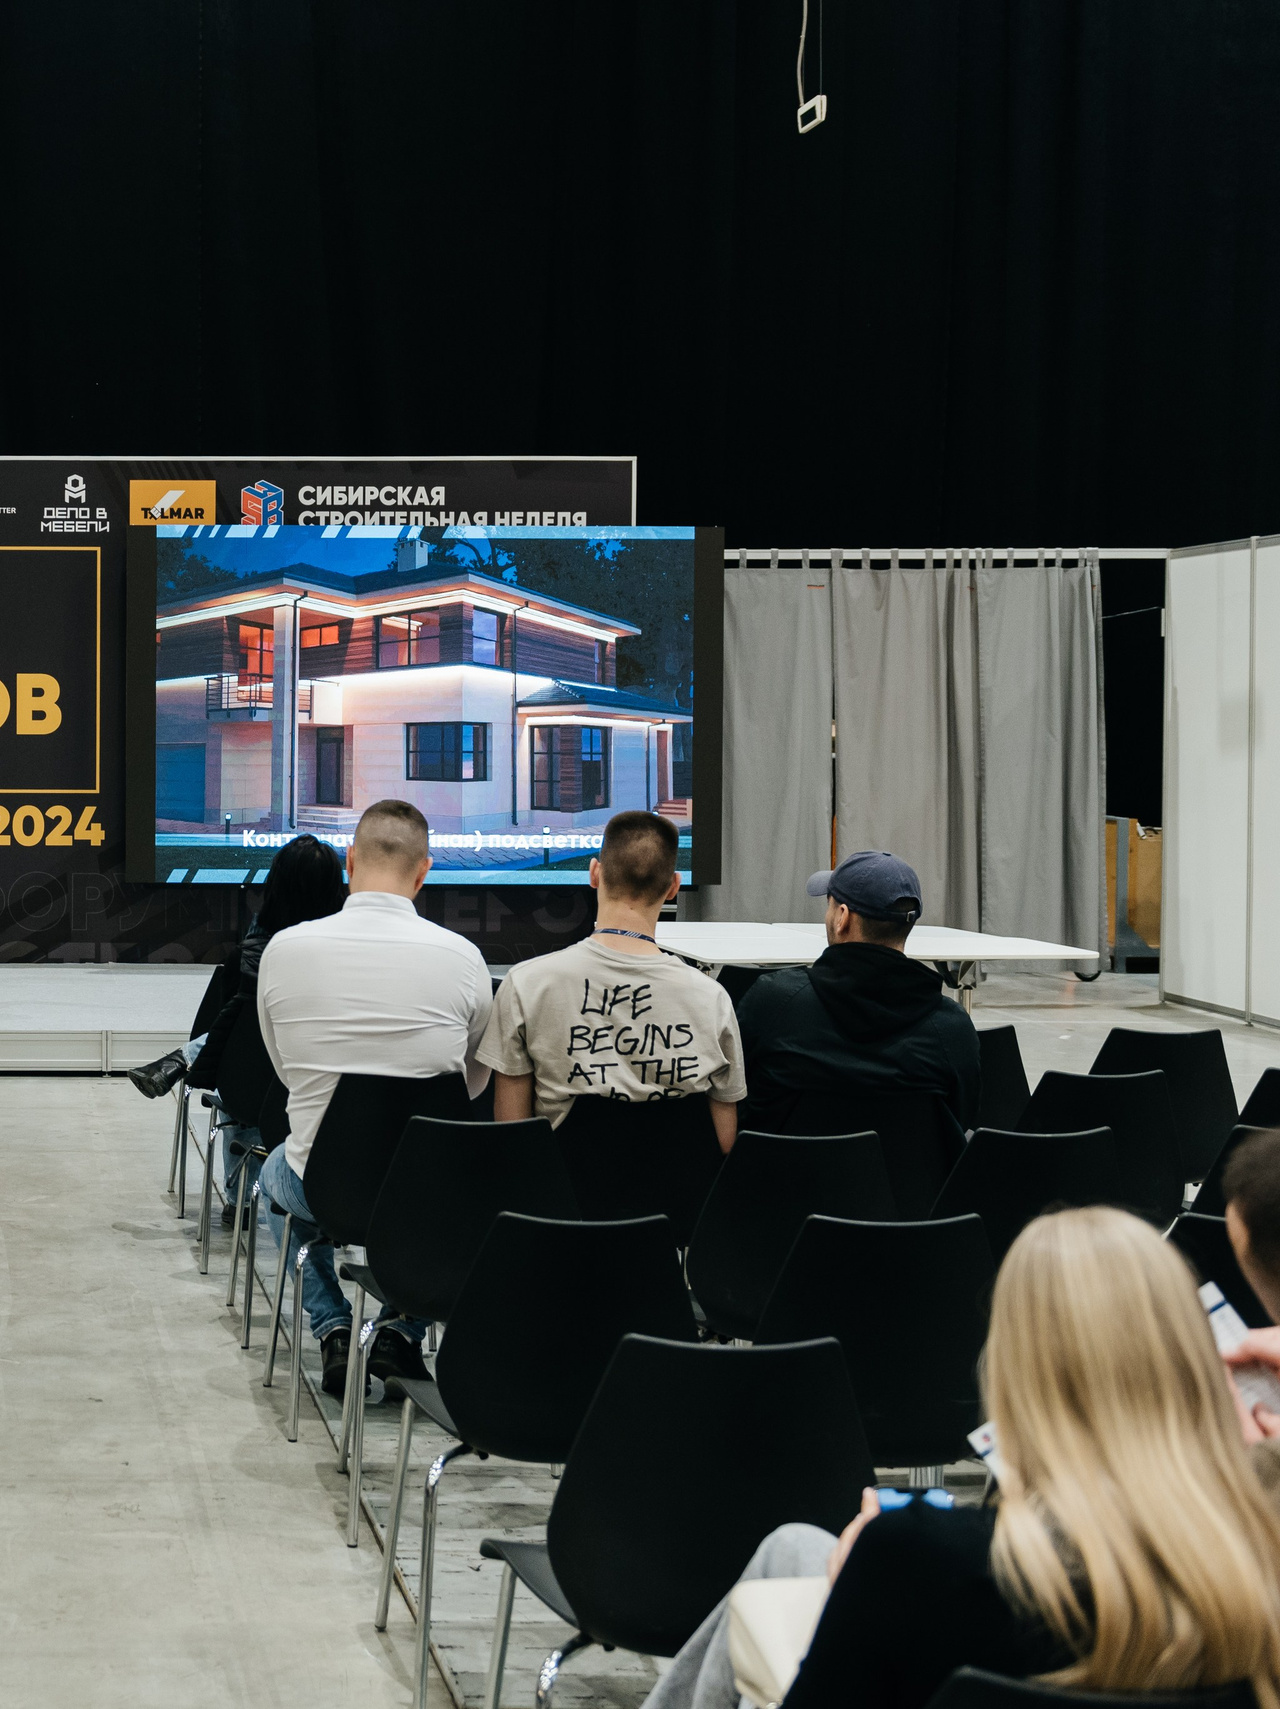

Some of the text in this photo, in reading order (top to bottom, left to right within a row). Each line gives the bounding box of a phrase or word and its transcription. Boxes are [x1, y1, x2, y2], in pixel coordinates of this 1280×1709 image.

[298, 486, 446, 506] СИБИРСКАЯ
[96, 507, 108, 519] В
[298, 511, 587, 527] СТРОИТЕЛЬНАЯ НЕДЕЛЯ
[40, 521, 110, 533] МЕБЕЛИ
[580, 978, 652, 1020] LIFE
[567, 1023, 694, 1056] BEGINS
[567, 1056, 700, 1086] AT THE
